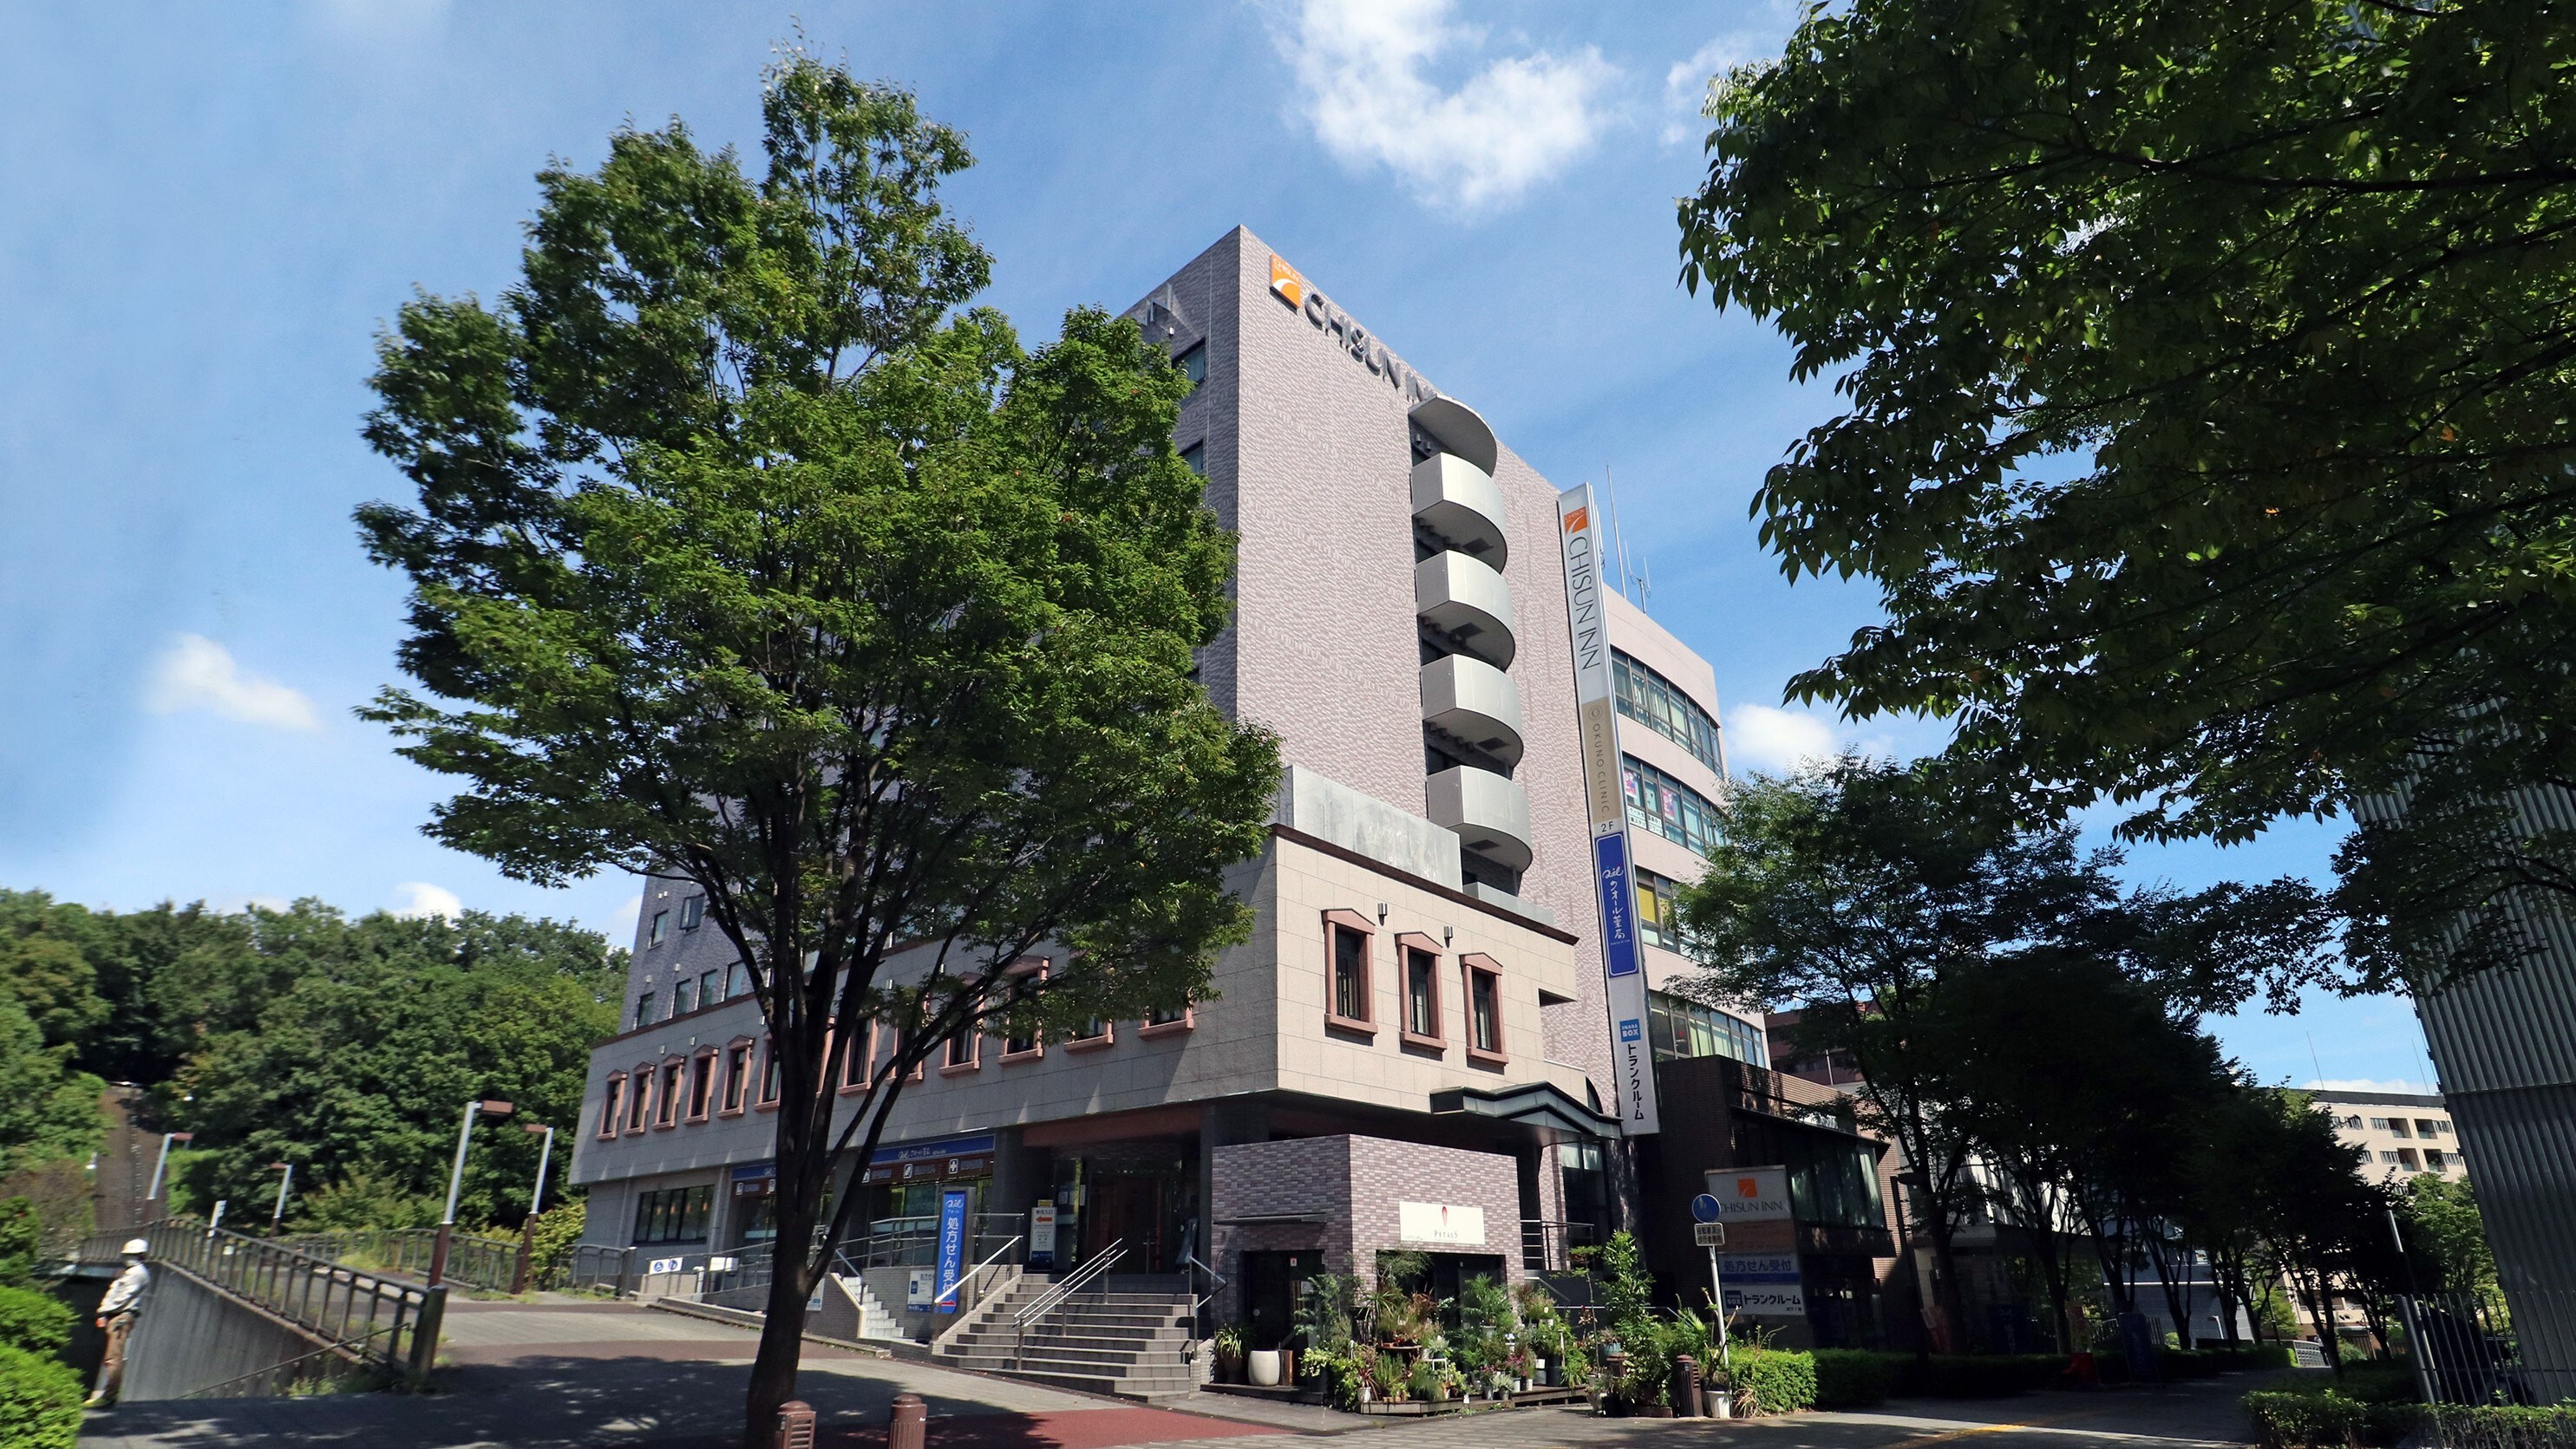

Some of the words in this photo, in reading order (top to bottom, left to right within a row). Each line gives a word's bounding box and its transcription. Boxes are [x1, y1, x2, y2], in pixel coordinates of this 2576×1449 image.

[1304, 291, 1401, 388] CHISUN
[1569, 537, 1596, 625] CHISUN
[1579, 627, 1600, 670] INN
[1592, 723, 1605, 767] OKUNO
[1600, 820, 1614, 833] 2F
[1610, 880, 1625, 939] クオール薬局
[1622, 1028, 1639, 1038] BOX
[1628, 1044, 1644, 1119] トランクルーム
[1762, 1200, 1783, 1211] INN
[1724, 1260, 1792, 1272] 処方せん受付
[1744, 1295, 1801, 1305] トランクルーム
